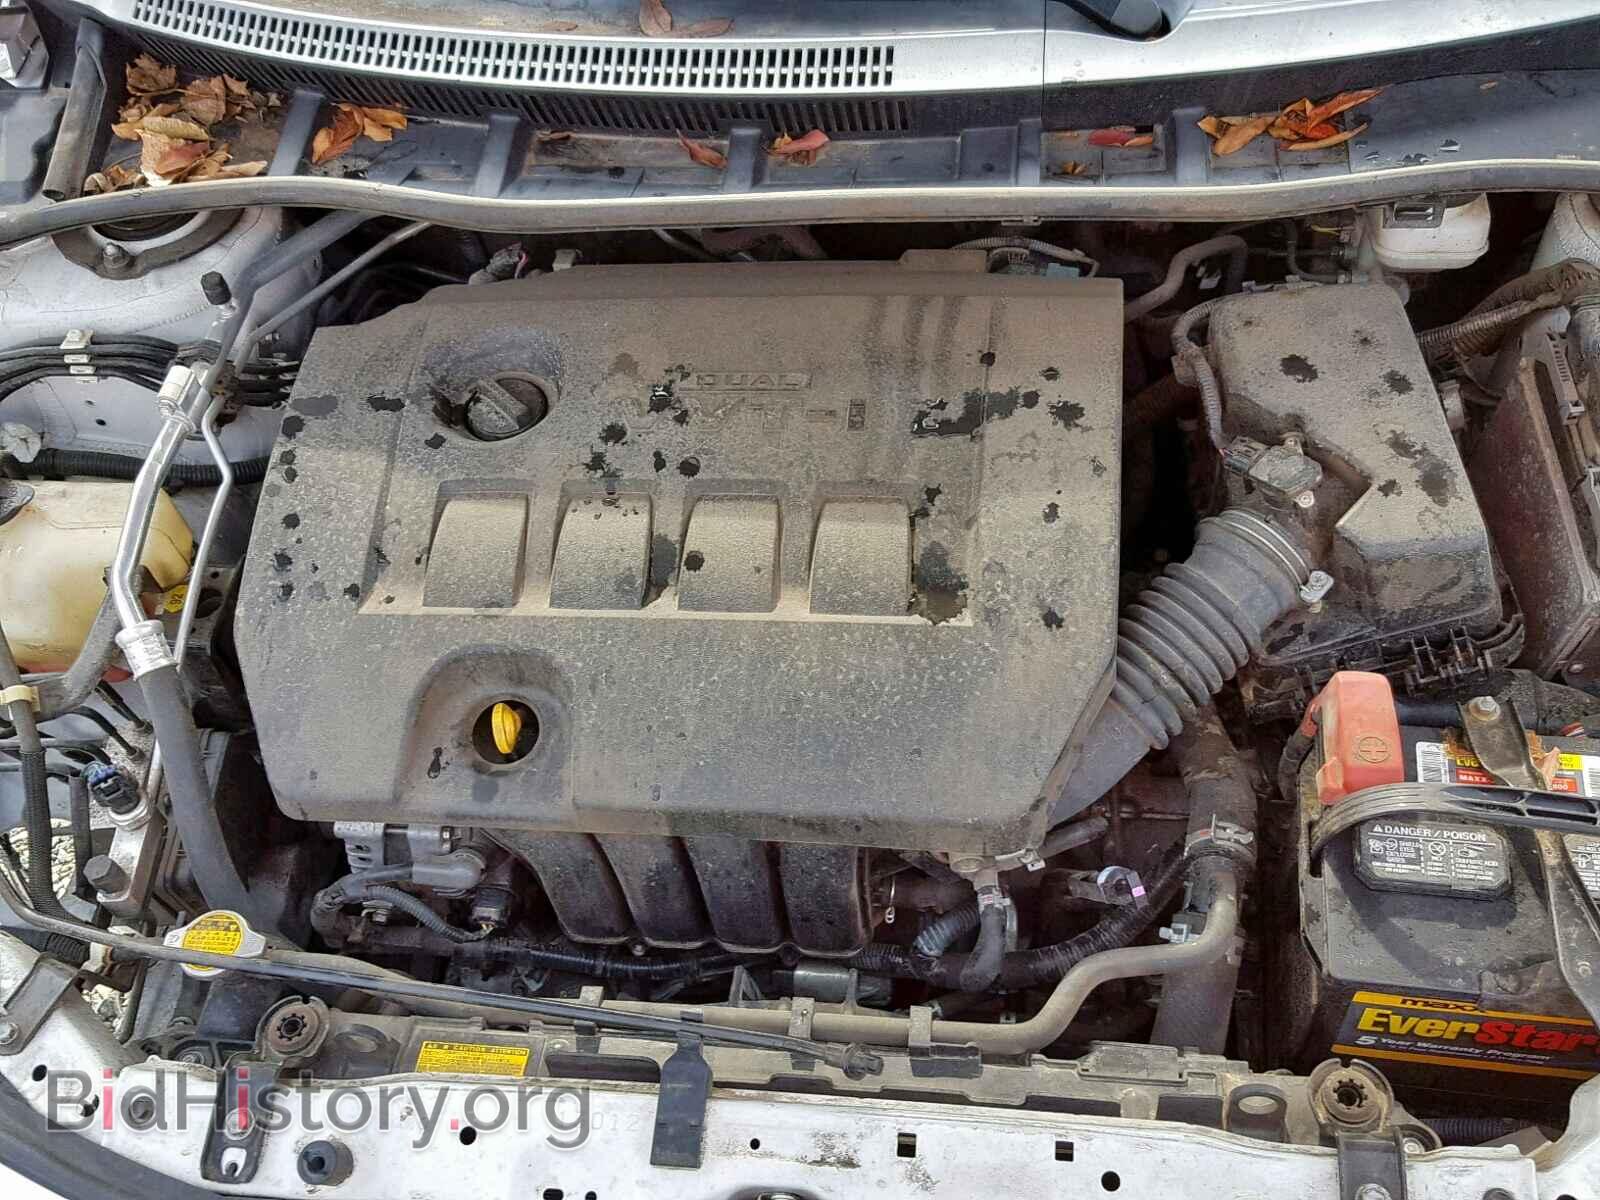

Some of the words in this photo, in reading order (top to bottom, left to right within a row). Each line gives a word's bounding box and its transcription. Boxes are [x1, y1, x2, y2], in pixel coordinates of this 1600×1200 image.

[696, 373, 801, 387] DUAL
[1384, 824, 1432, 837] DANGER
[1443, 830, 1487, 842] POISON
[1357, 1007, 1600, 1056] EverStar
[1354, 1035, 1379, 1046] 5
[1381, 1037, 1415, 1047] Year
[1416, 1041, 1484, 1055] Warranty
[1486, 1048, 1553, 1061] Program
